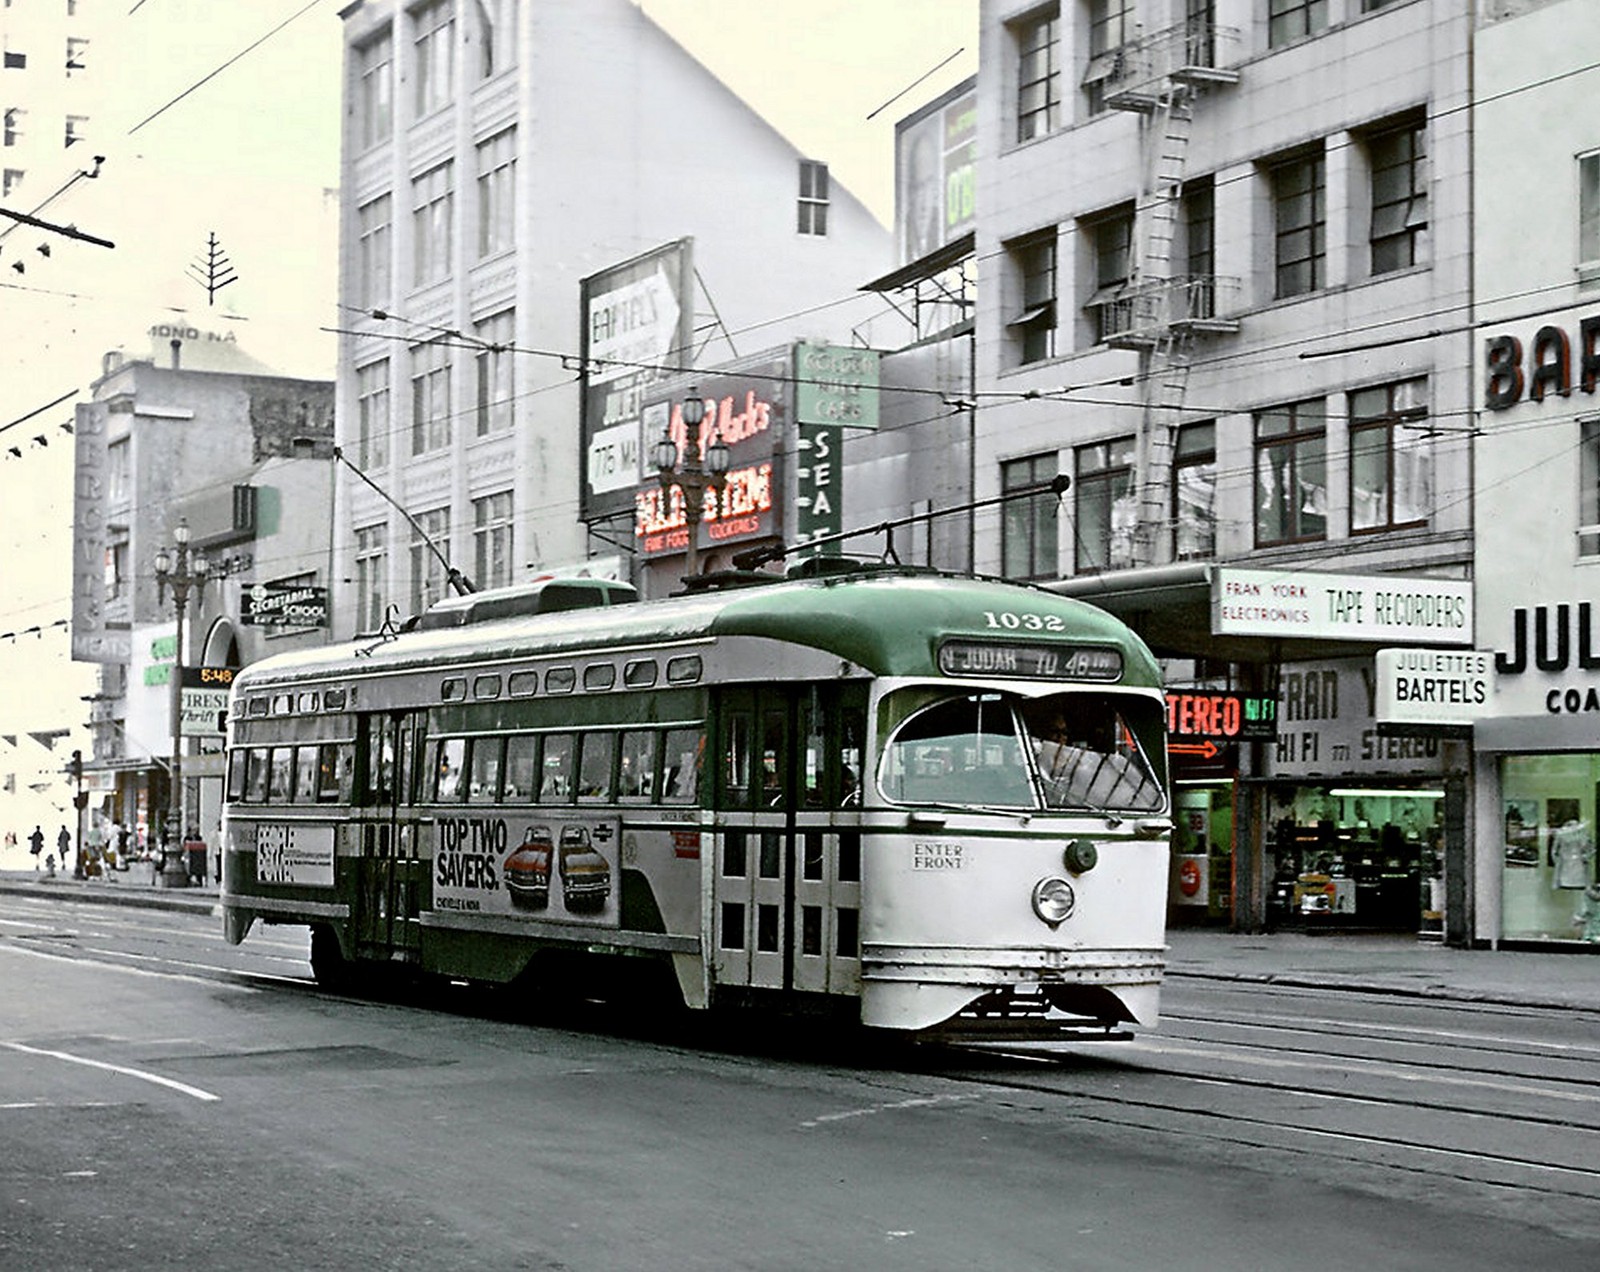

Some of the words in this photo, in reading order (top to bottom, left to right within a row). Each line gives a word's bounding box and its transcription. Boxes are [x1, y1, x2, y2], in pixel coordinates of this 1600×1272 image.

[1226, 582, 1261, 596] FRAN
[1271, 584, 1307, 599] YORK
[984, 611, 1065, 631] 1032
[1222, 606, 1311, 624] ELECTRONICS
[1326, 589, 1363, 624] TAPE
[1376, 592, 1465, 629] RECORDERS
[962, 649, 1017, 671] JUDAH
[1546, 688, 1600, 714] COA
[1165, 694, 1240, 737] TEREO
[1276, 733, 1296, 763] HI
[1301, 732, 1319, 763] FI
[1361, 729, 1438, 761] STEREO
[438, 817, 468, 852] TOP
[470, 818, 508, 854] TWO
[914, 843, 963, 857] ENTER
[437, 853, 500, 891] SAVERS.
[914, 857, 962, 869] FRONT
